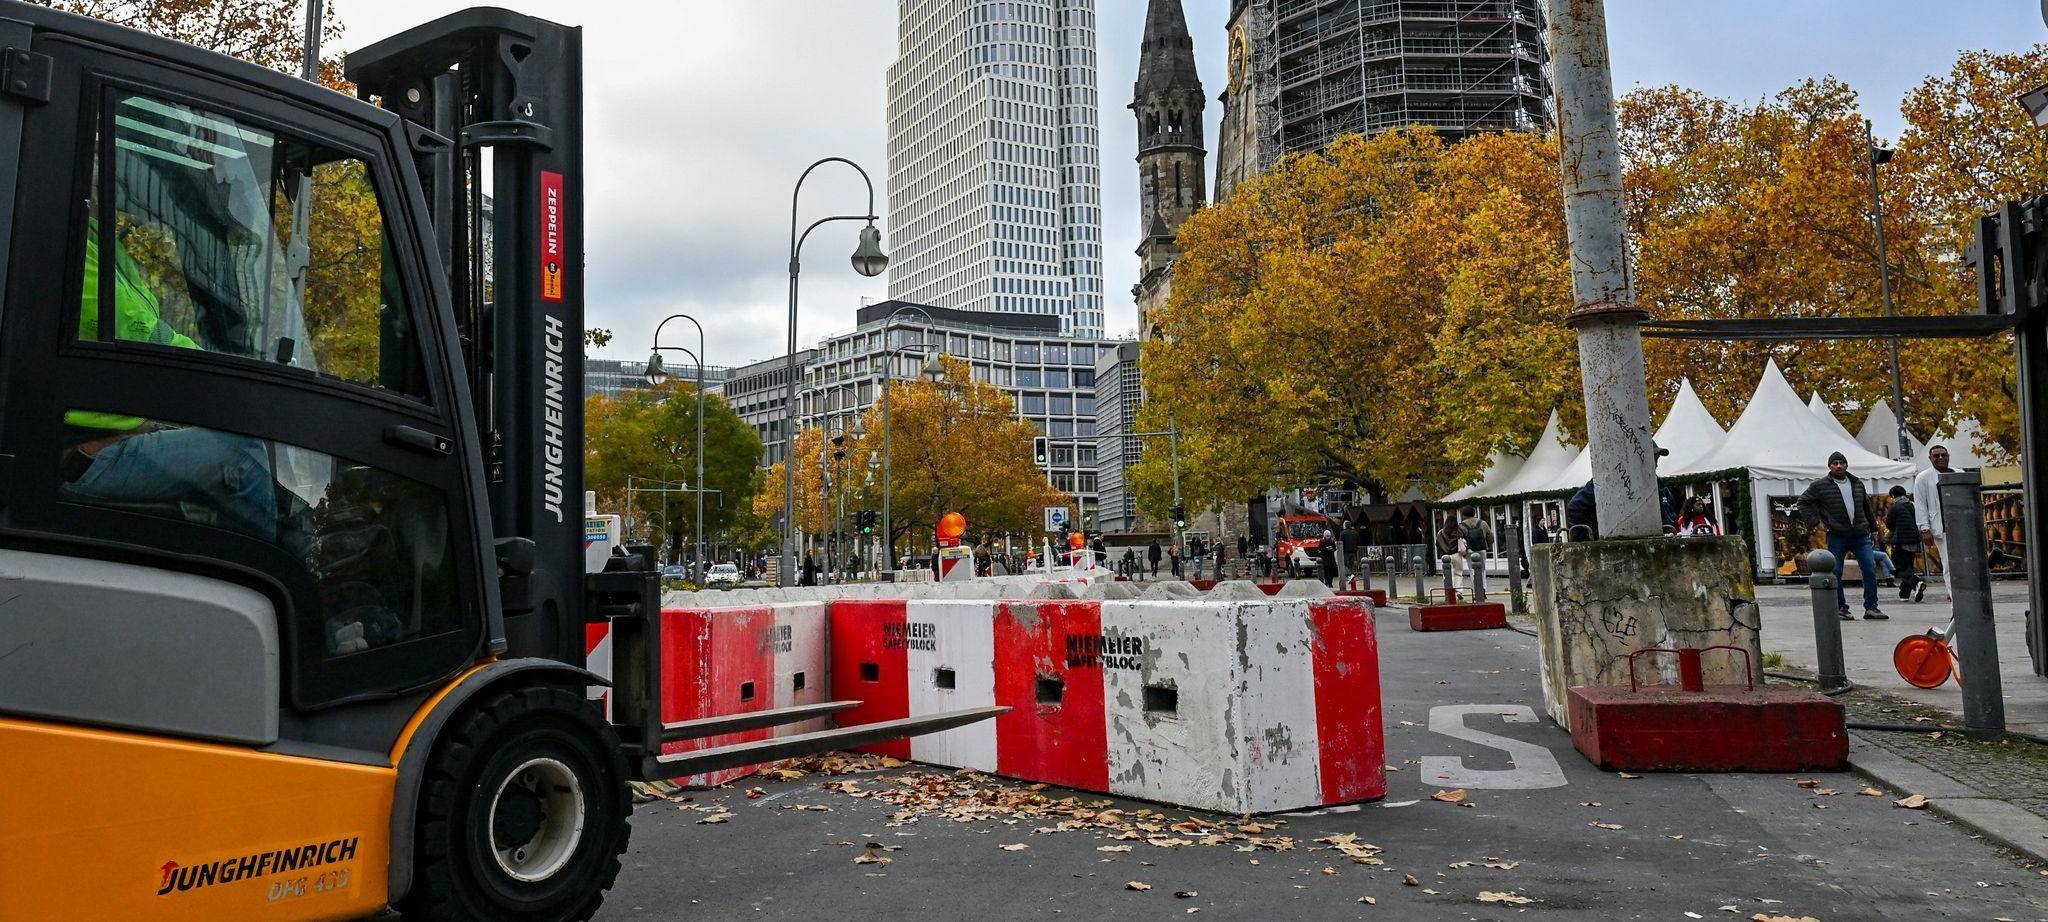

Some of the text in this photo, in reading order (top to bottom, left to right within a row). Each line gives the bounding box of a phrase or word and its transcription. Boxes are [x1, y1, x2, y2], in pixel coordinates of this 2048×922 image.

[548, 187, 557, 254] ZEPPELIN
[545, 314, 563, 523] JUNGHEINRICH
[883, 622, 936, 639] NIEMEIER
[1066, 635, 1143, 655] NIEMEIER
[1420, 703, 1569, 790] S
